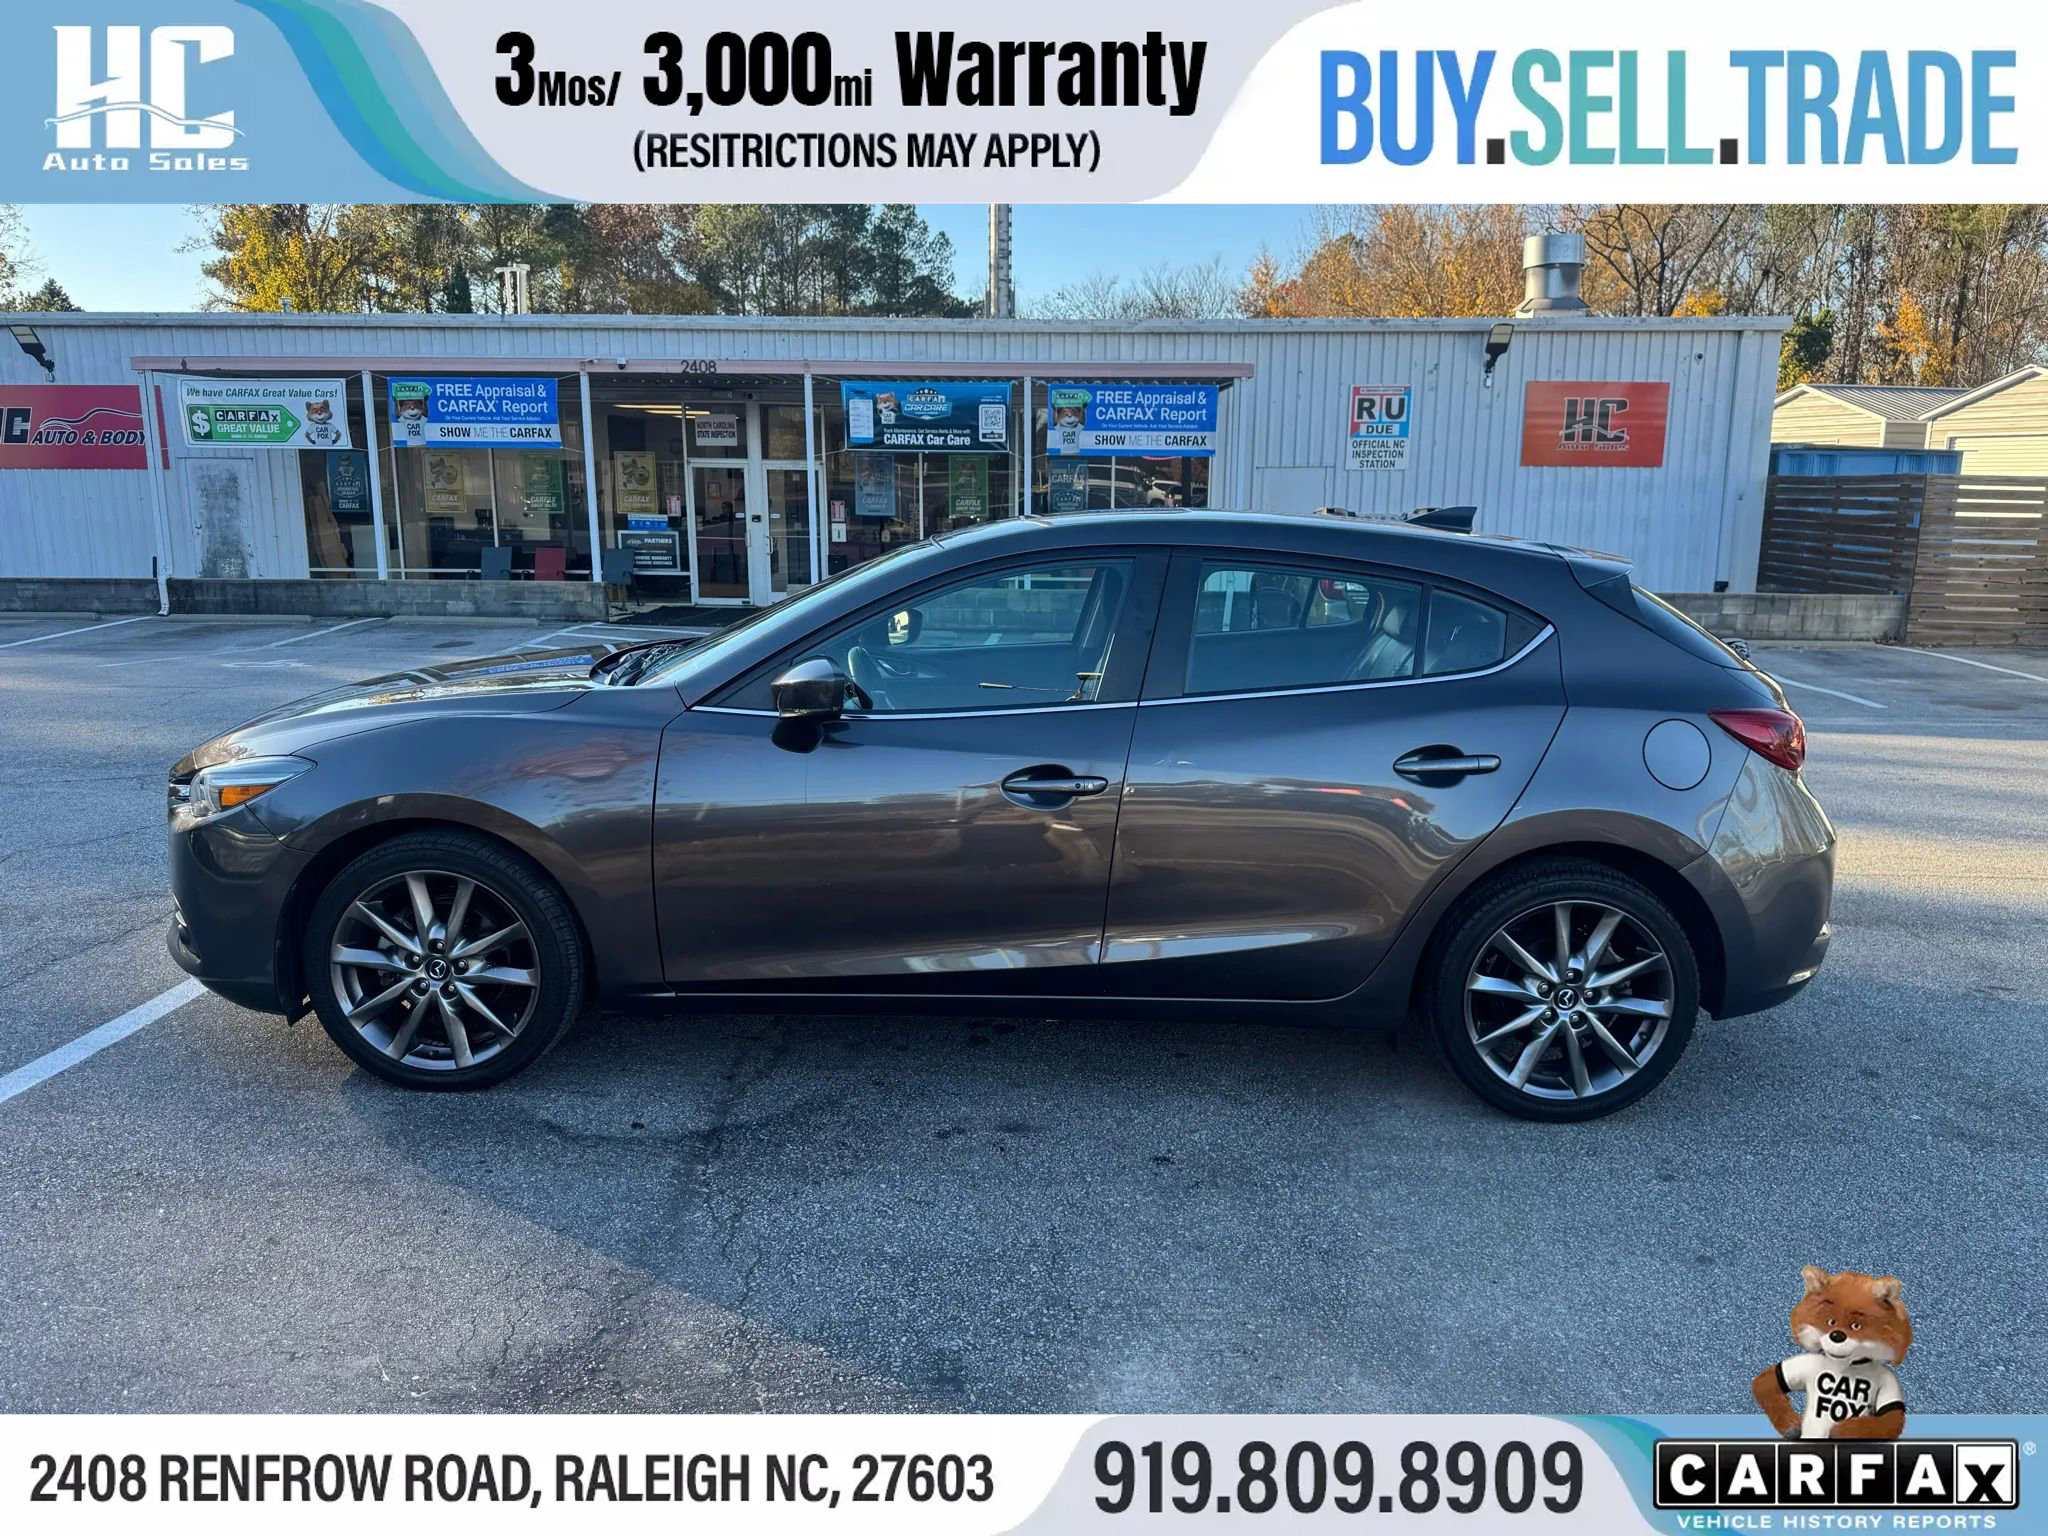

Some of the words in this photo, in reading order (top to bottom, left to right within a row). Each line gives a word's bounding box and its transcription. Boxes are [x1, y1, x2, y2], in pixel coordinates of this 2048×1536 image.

[681, 360, 717, 374] 2408
[186, 387, 200, 397] We
[202, 387, 223, 397] have
[226, 388, 260, 398] CARFAX
[262, 388, 286, 398] Great
[288, 388, 312, 398] Value
[314, 388, 338, 398] Cars!
[436, 384, 472, 397] FREE
[475, 384, 534, 400] Appraisal
[537, 384, 546, 397] &
[1096, 391, 1132, 404] FREE
[1134, 391, 1195, 408] Appraisal
[1198, 392, 1207, 404] &
[438, 399, 497, 413] CARFAX
[502, 400, 548, 416] Report
[1356, 398, 1376, 420] R
[1385, 398, 1406, 420] U
[215, 411, 280, 422] CARFAX
[1096, 407, 1154, 420] CARFAX
[1160, 408, 1207, 423] Report
[1561, 397, 1630, 444] HC
[0, 407, 32, 444] C
[217, 423, 247, 433] GREAT
[249, 423, 280, 433] VALUE
[696, 421, 712, 429] NORTH
[713, 421, 735, 429] CAROLINA
[1366, 424, 1393, 434] DUE
[32, 430, 79, 446] AUTO
[81, 430, 97, 446] &
[440, 427, 471, 438] SHOW
[474, 427, 490, 438] ME
[490, 427, 508, 438] THE
[510, 427, 552, 438] CARFAX
[697, 430, 710, 438] STATE
[711, 430, 736, 438] INSPECTION
[884, 434, 924, 445] CARFAX
[926, 434, 945, 445] Car
[947, 434, 971, 445] Care
[1094, 435, 1126, 446] SHOW
[1128, 435, 1141, 446] ME
[1142, 435, 1163, 446] THE
[1165, 436, 1207, 446] CARFAX
[1352, 440, 1390, 448] OFFICIAL
[1393, 440, 1406, 448] NC
[1352, 450, 1404, 459] INSPECTION
[1360, 460, 1396, 469] STATION
